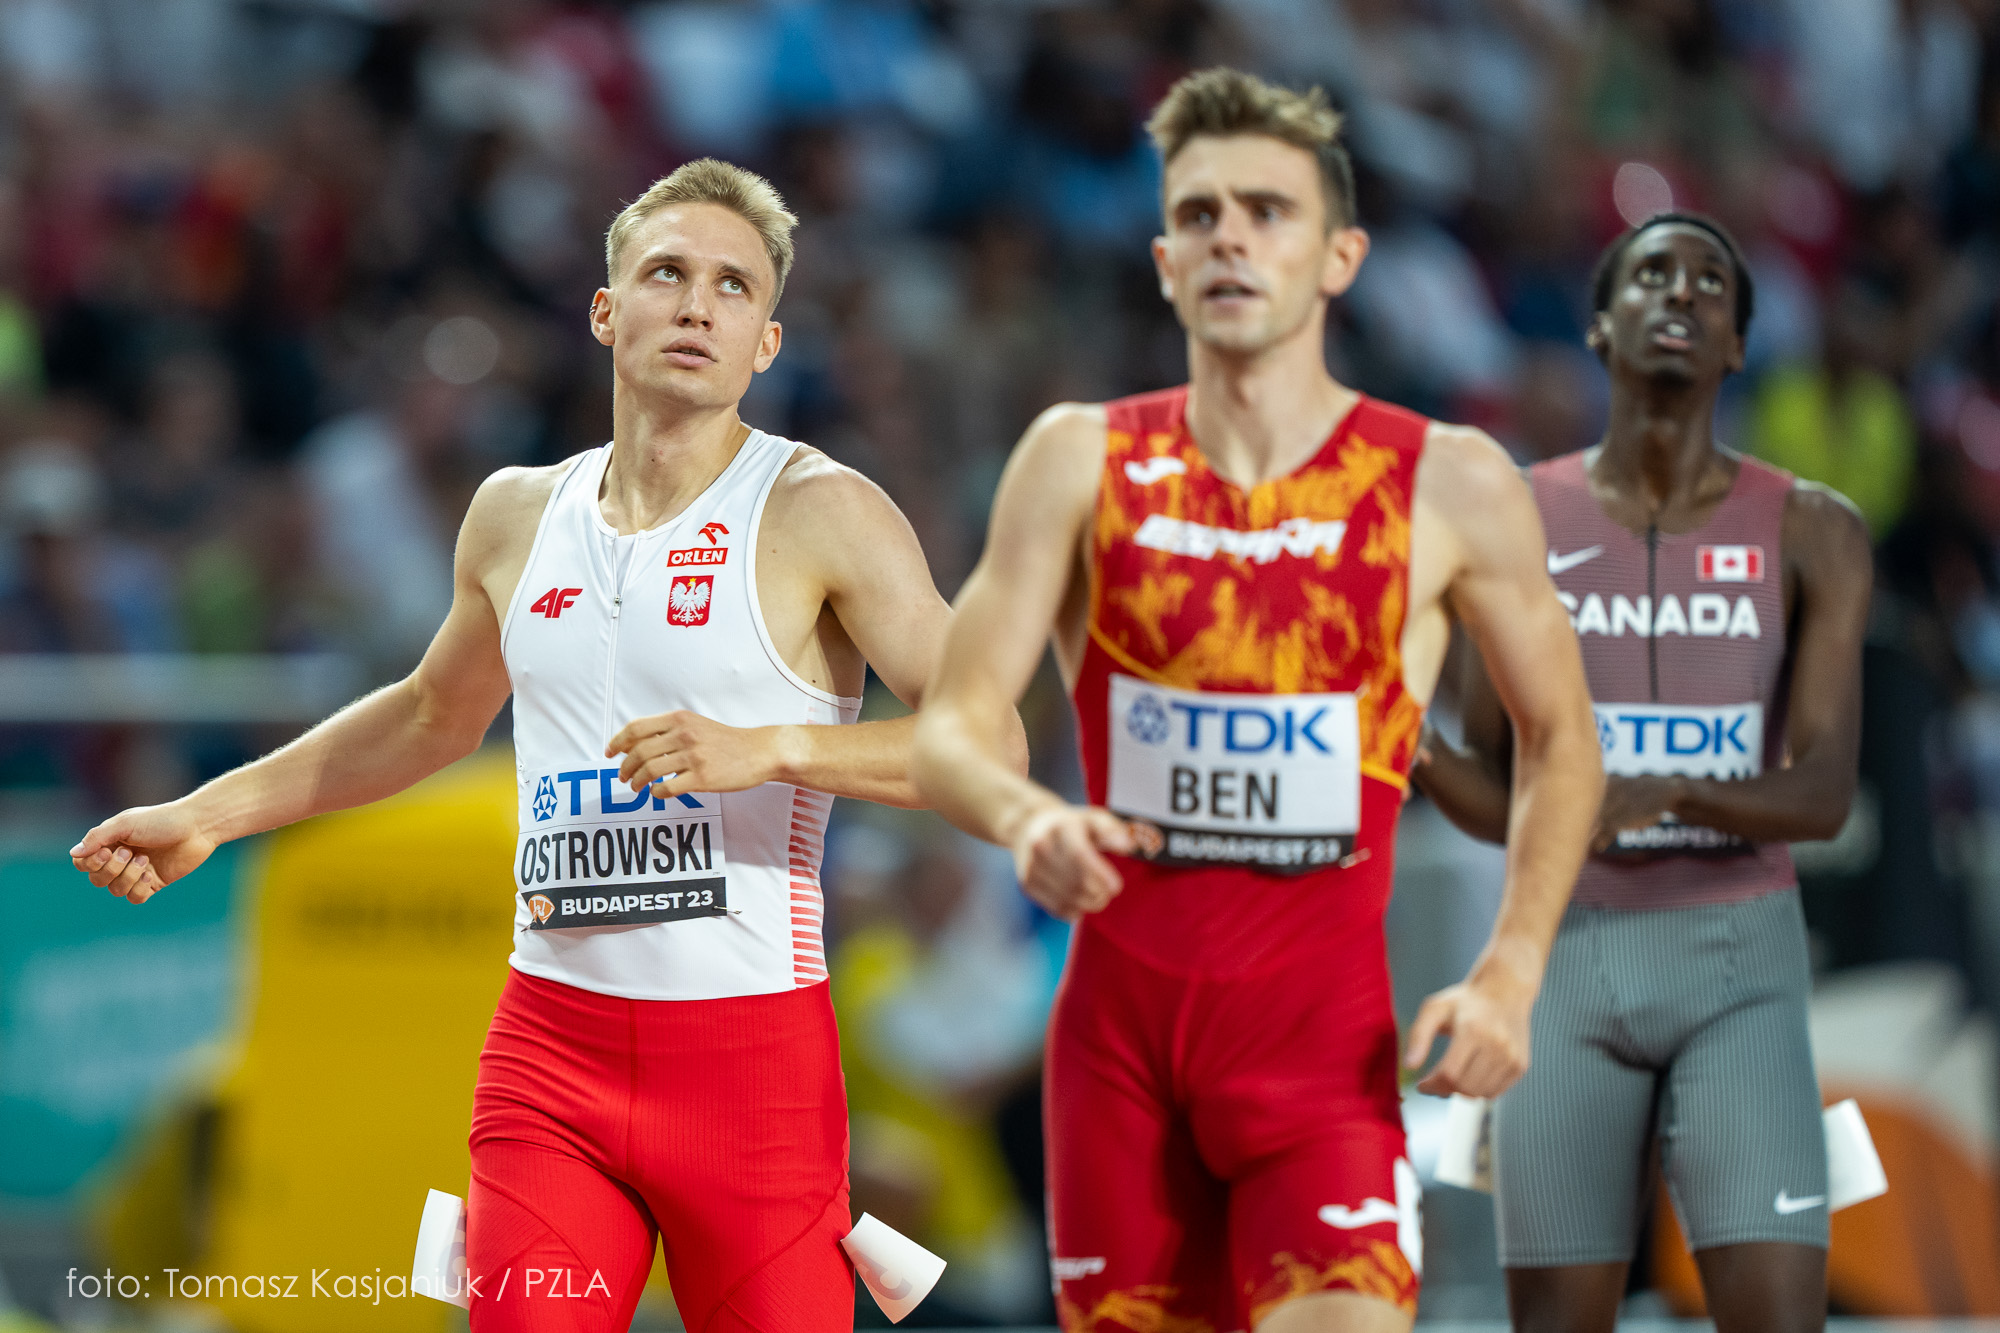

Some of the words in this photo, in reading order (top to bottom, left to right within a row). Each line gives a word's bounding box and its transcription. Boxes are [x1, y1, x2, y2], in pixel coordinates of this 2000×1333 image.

[670, 549, 725, 565] ORLEN
[530, 587, 583, 618] 4F
[1169, 702, 1335, 756] TDK
[1618, 714, 1747, 756] TDK
[1170, 764, 1280, 821] BEN
[521, 822, 713, 886] OSTROWSKI
[561, 892, 684, 916] BUDAPEST
[687, 890, 714, 908] 23
